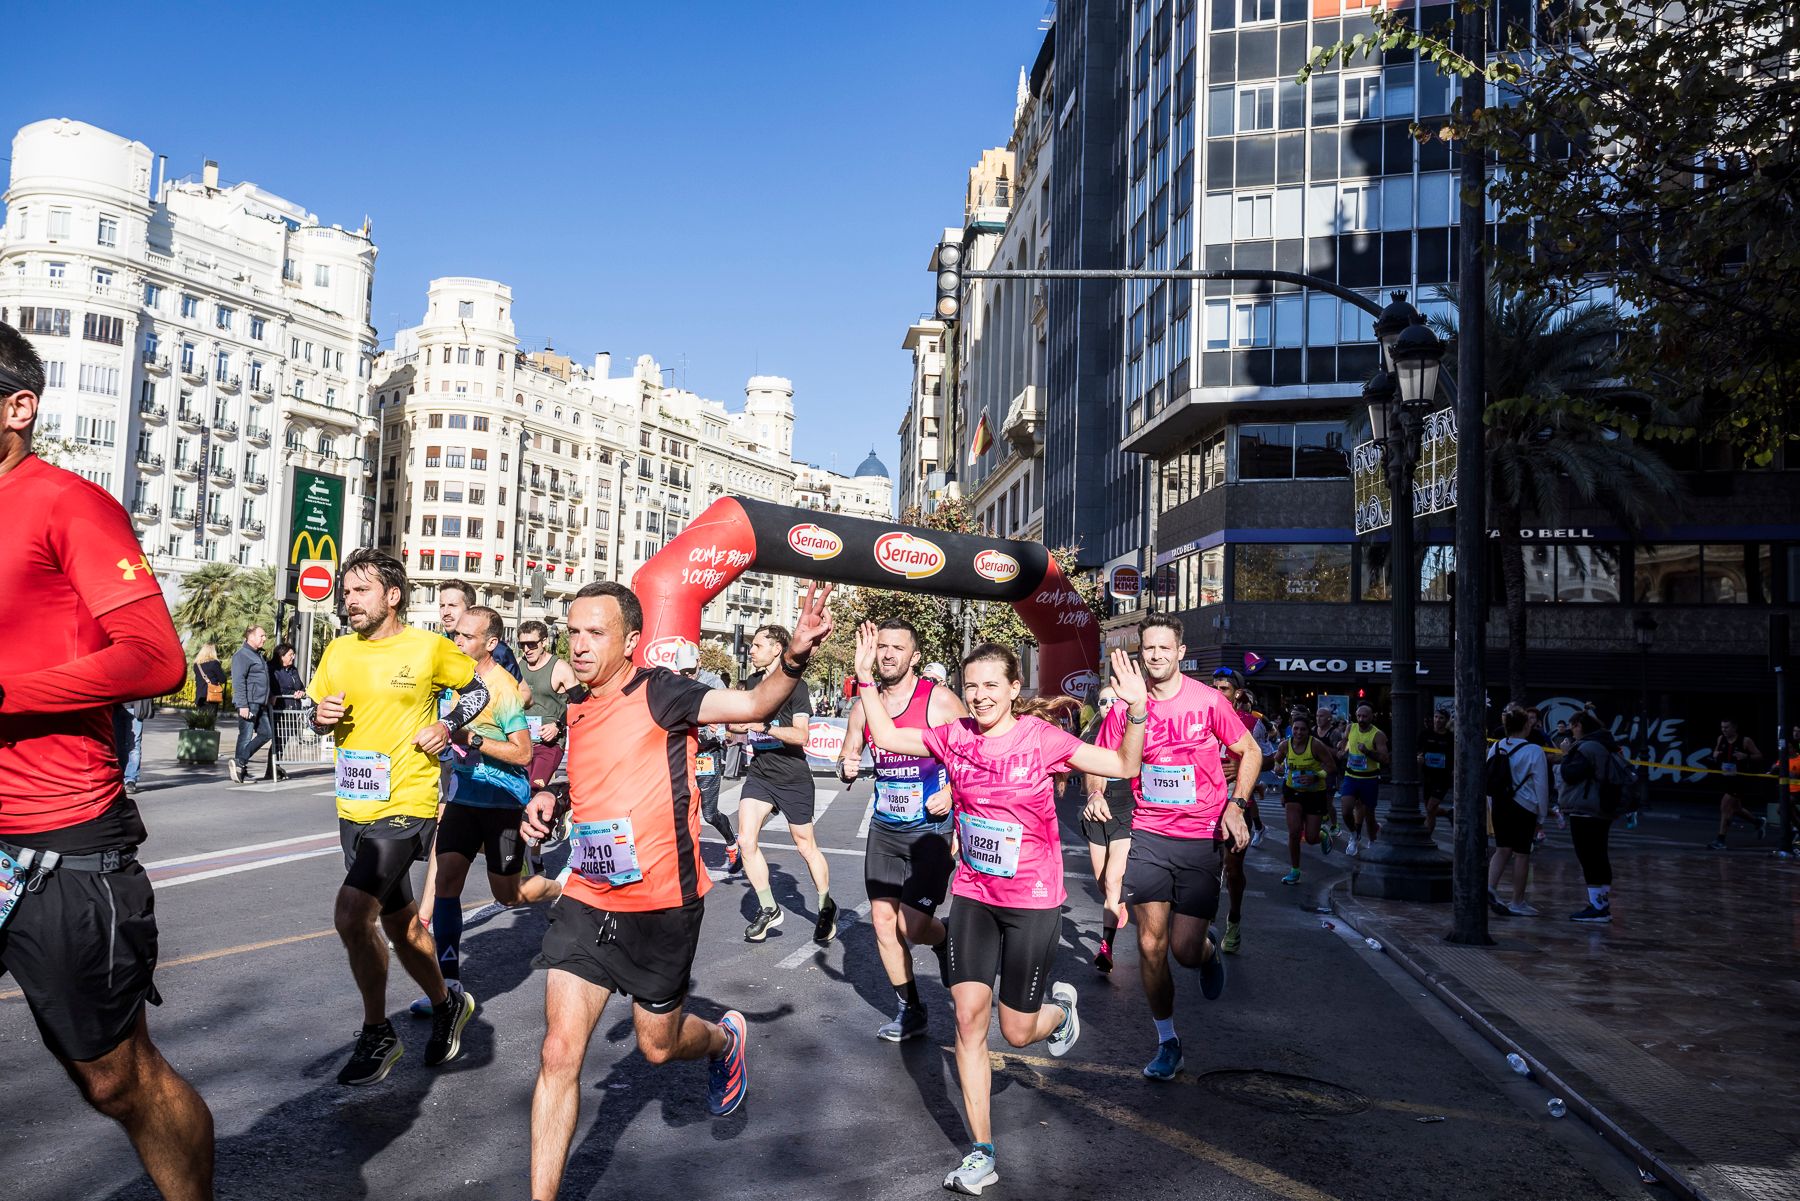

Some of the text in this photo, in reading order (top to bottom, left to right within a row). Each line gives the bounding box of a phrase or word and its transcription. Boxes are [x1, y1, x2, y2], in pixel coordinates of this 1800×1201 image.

[794, 531, 837, 551] Serrano
[1538, 528, 1595, 538] BELL
[689, 545, 753, 567] COME BIEN
[883, 542, 938, 567] Serrano
[1171, 542, 1196, 558] TACO BELL
[979, 557, 1015, 573] Serrano
[1114, 582, 1139, 590] KING
[1035, 588, 1066, 607] COME
[1274, 658, 1429, 674] TACO BEL
[344, 766, 372, 779] 13840
[340, 777, 380, 790] José Luis
[1153, 778, 1180, 788] 17531
[887, 794, 910, 804] 13805
[889, 804, 906, 813] Iván
[969, 834, 1000, 852] 18281
[580, 859, 616, 875] RUBEN
